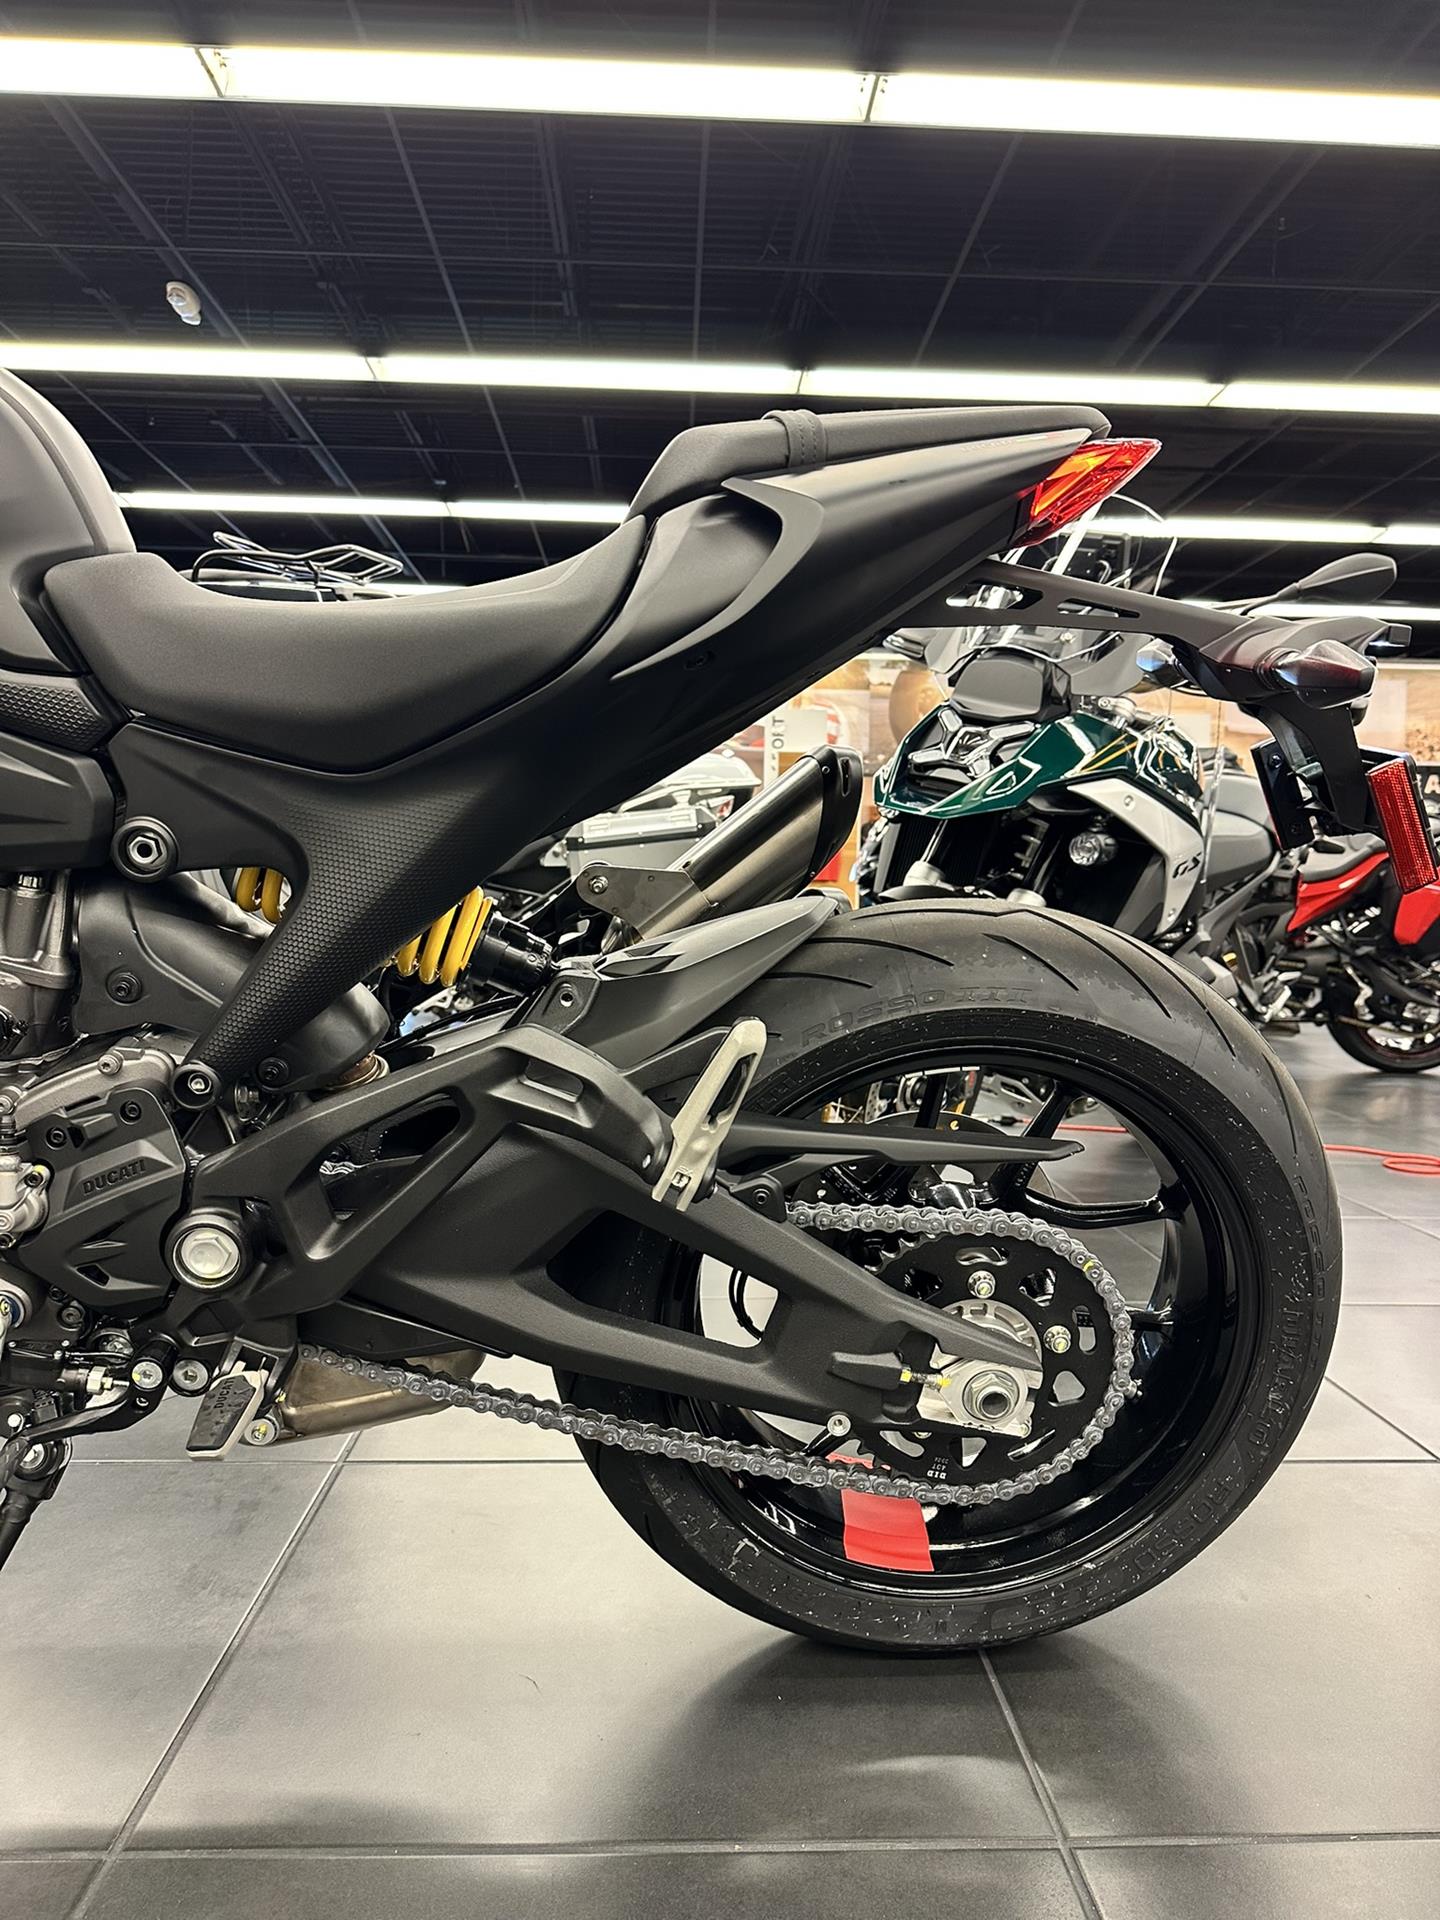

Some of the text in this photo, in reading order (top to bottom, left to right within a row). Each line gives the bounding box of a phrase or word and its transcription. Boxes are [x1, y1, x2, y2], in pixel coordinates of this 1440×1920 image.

[1172, 851, 1202, 879] GS
[801, 989, 945, 1044] ROSSO
[82, 1159, 148, 1197] DUCATI
[213, 1377, 236, 1409] DUCATI
[926, 1470, 947, 1480] DID
